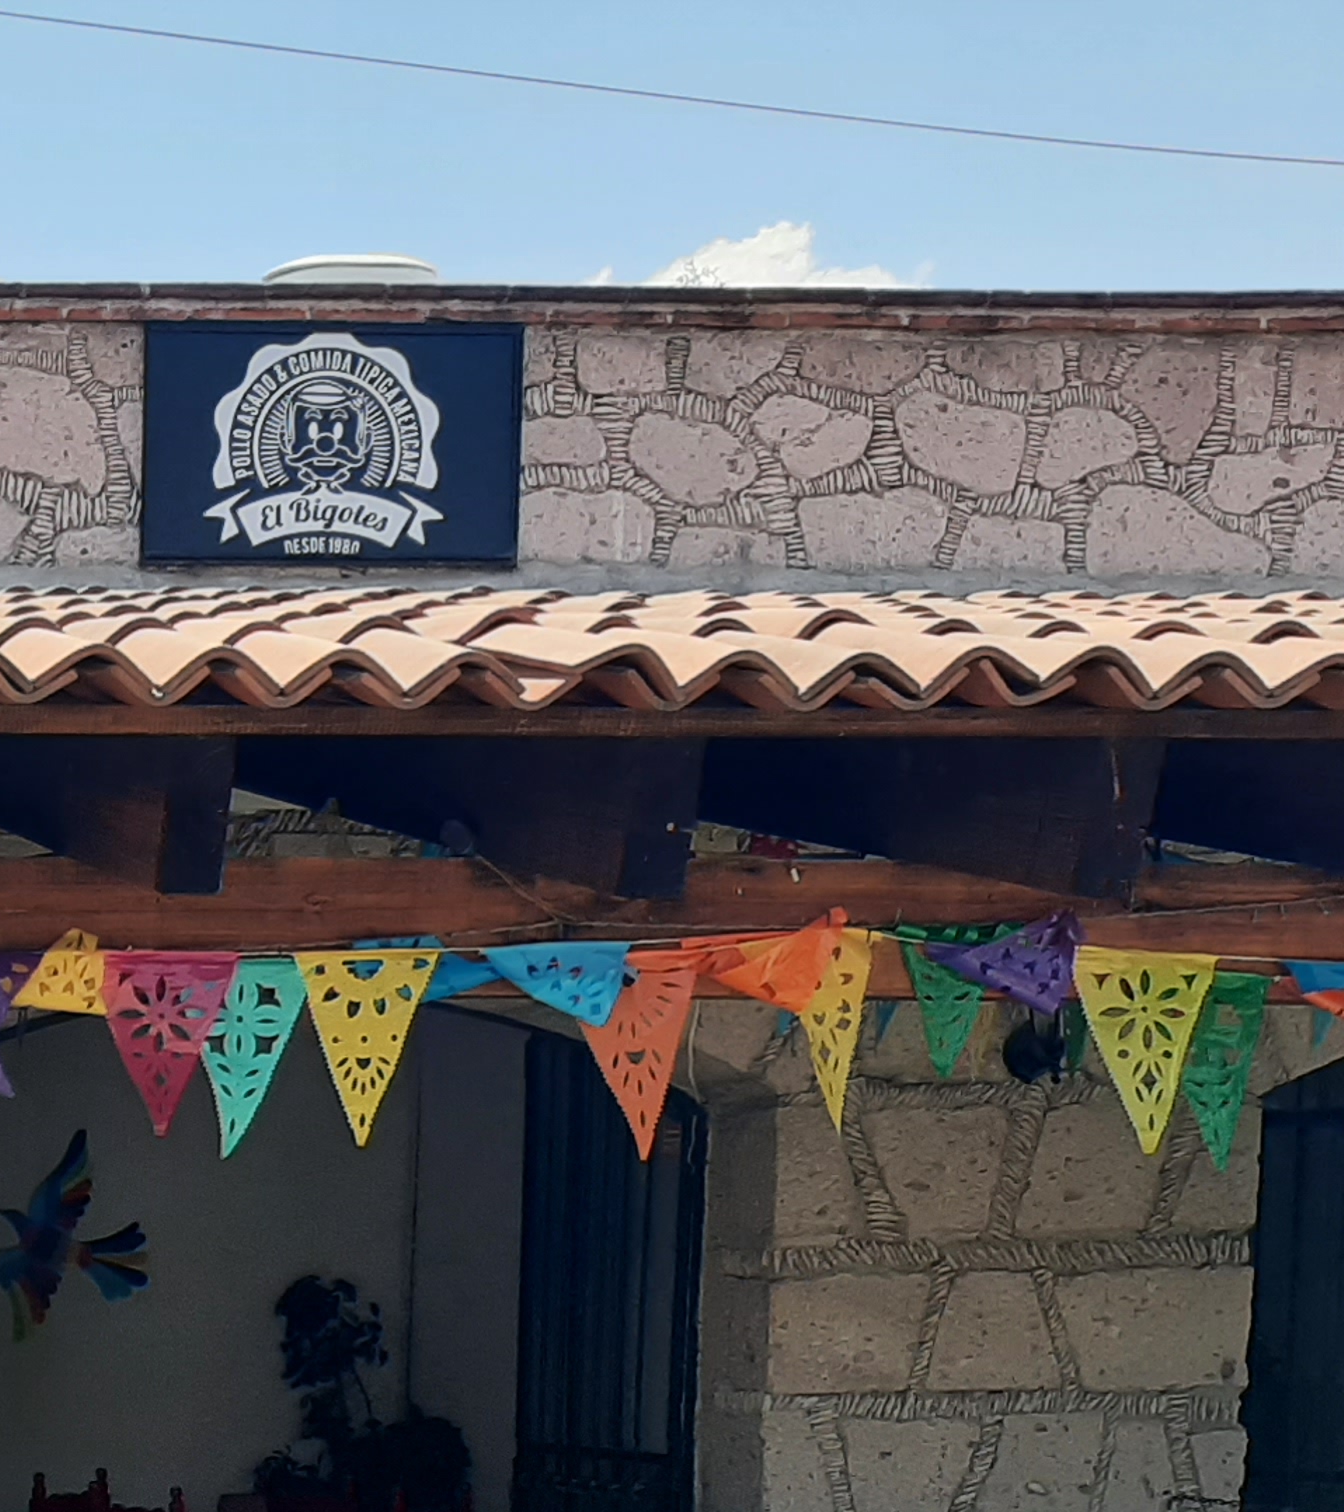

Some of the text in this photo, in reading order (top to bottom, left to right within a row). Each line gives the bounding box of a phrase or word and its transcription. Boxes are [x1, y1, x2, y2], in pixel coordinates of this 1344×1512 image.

[273, 363, 290, 383] &
[287, 350, 353, 375] COMIDA
[236, 373, 278, 427] ASADO
[231, 428, 254, 480] POLLO
[390, 397, 420, 483] MEXICANA
[260, 497, 389, 533] El Bigotes
[283, 536, 361, 556] DESDE 1980
